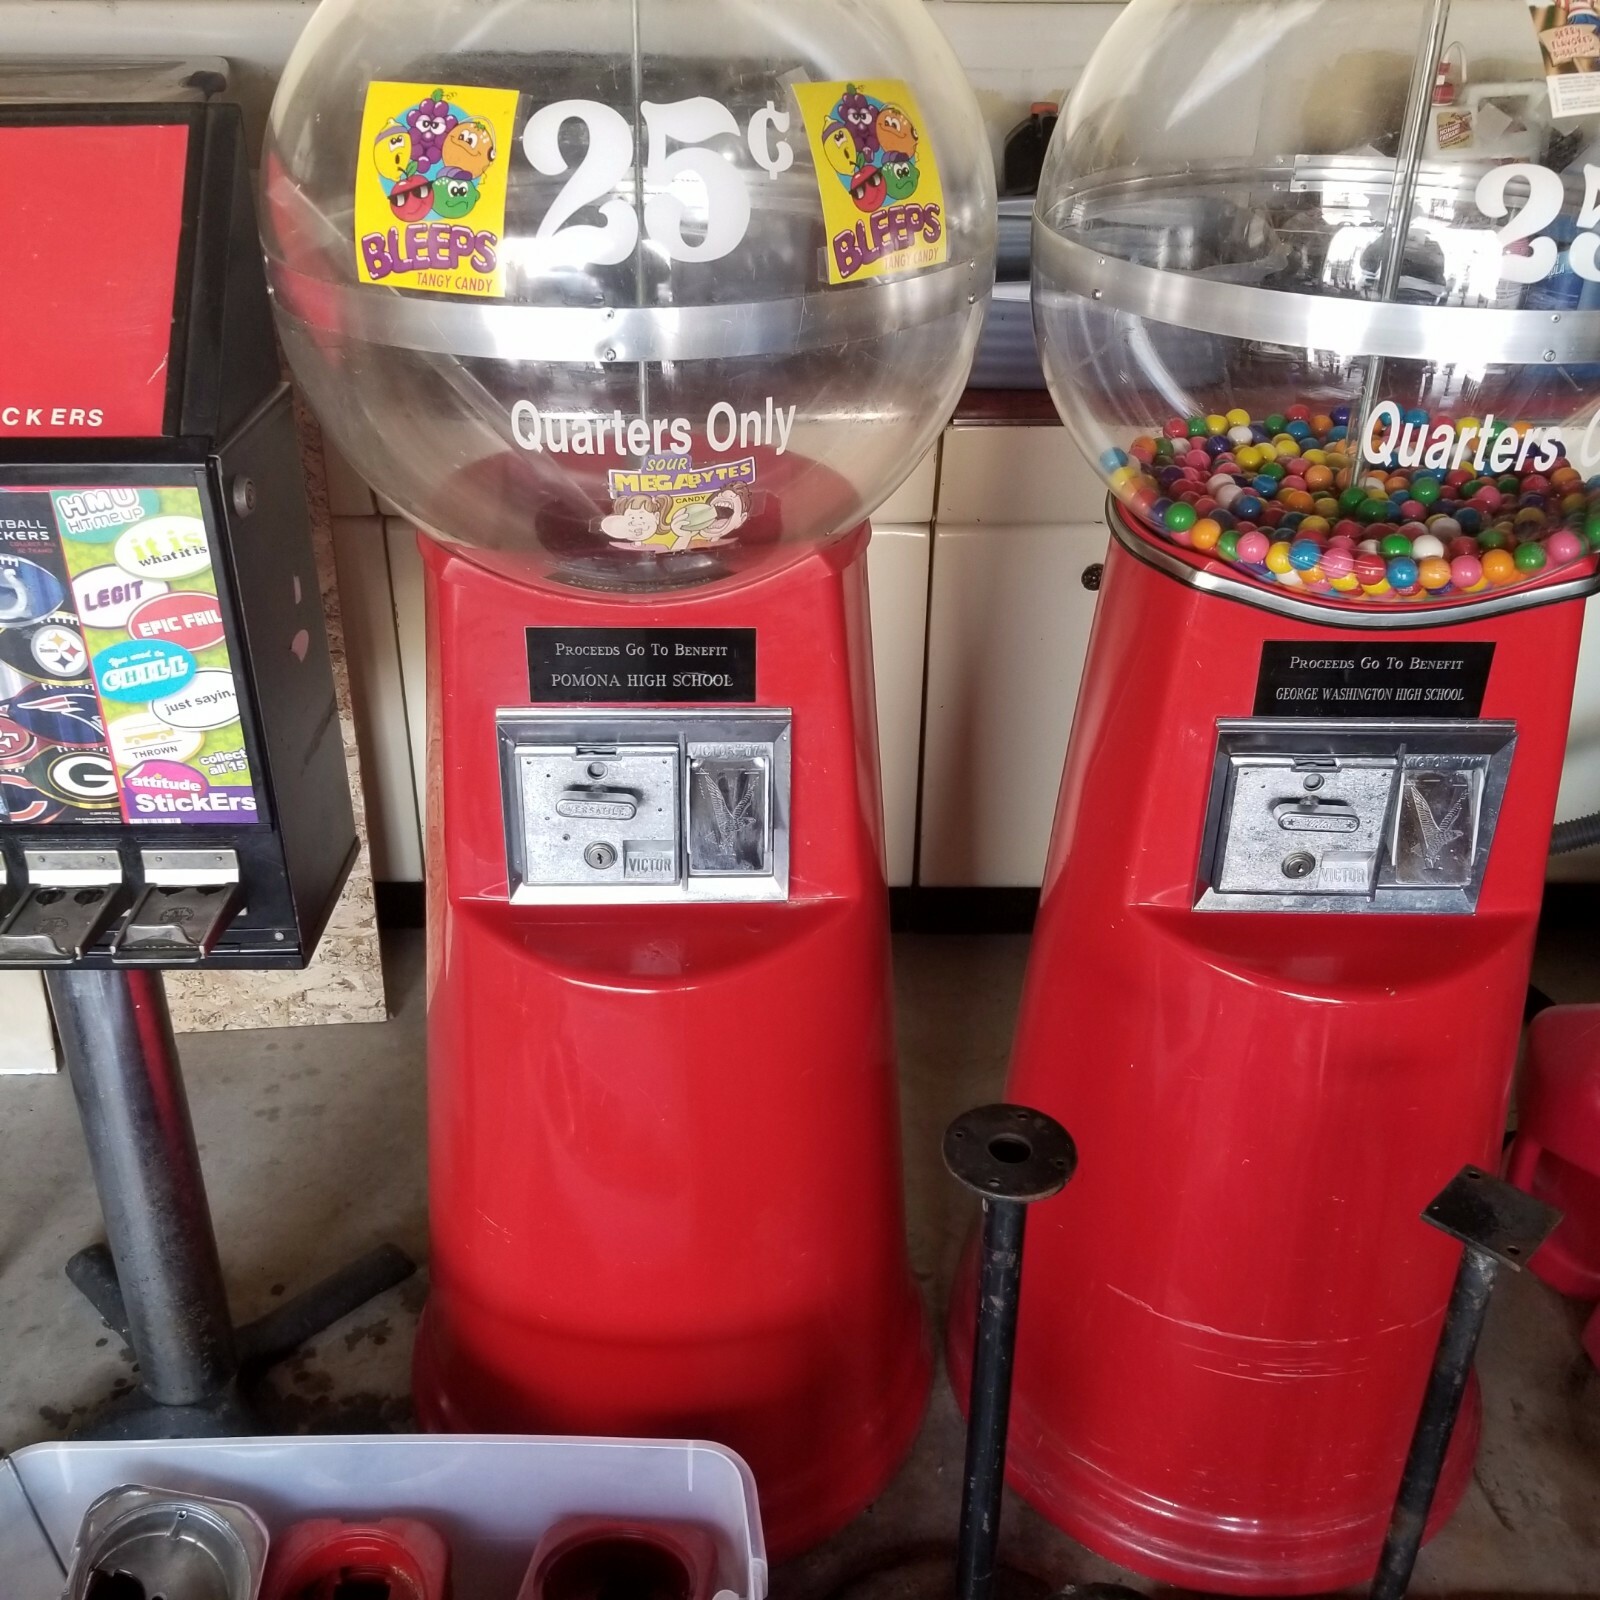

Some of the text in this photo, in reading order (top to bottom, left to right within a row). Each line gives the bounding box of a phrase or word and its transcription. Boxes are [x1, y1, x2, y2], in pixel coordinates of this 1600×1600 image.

[833, 203, 942, 279] BLEEPS
[361, 223, 498, 281] BLEEPS
[883, 247, 940, 271] TANGY CANDY
[416, 271, 494, 293] TANGY CANDY
[510, 396, 797, 456] Quarters Only
[1362, 400, 1564, 473] Quarters
[645, 456, 688, 473] SOUR
[675, 495, 708, 504] CANDY
[131, 530, 202, 561] it is
[138, 545, 208, 567] what it is
[84, 579, 144, 612] LEGIT
[138, 609, 223, 637] EPIC FAIL
[555, 642, 621, 657] PROCEEDS
[674, 642, 728, 656] BENEFIT
[103, 656, 187, 691] CHILL
[1289, 656, 1355, 670] PROCEEDS
[1408, 656, 1465, 670] BENEFIT
[551, 673, 734, 688] POMONA HIGH SCHOOL
[164, 688, 236, 716] just sayin.
[1275, 687, 1465, 701] GEORGE WASHINGTON HIGH SCHOOL
[132, 745, 179, 760] THROWN
[200, 747, 248, 766] collect
[209, 760, 247, 776] all 15
[131, 772, 202, 792] attitude
[135, 792, 257, 813] StickErs
[628, 857, 672, 873] VICTOR
[1320, 867, 1366, 882] VICTOR
